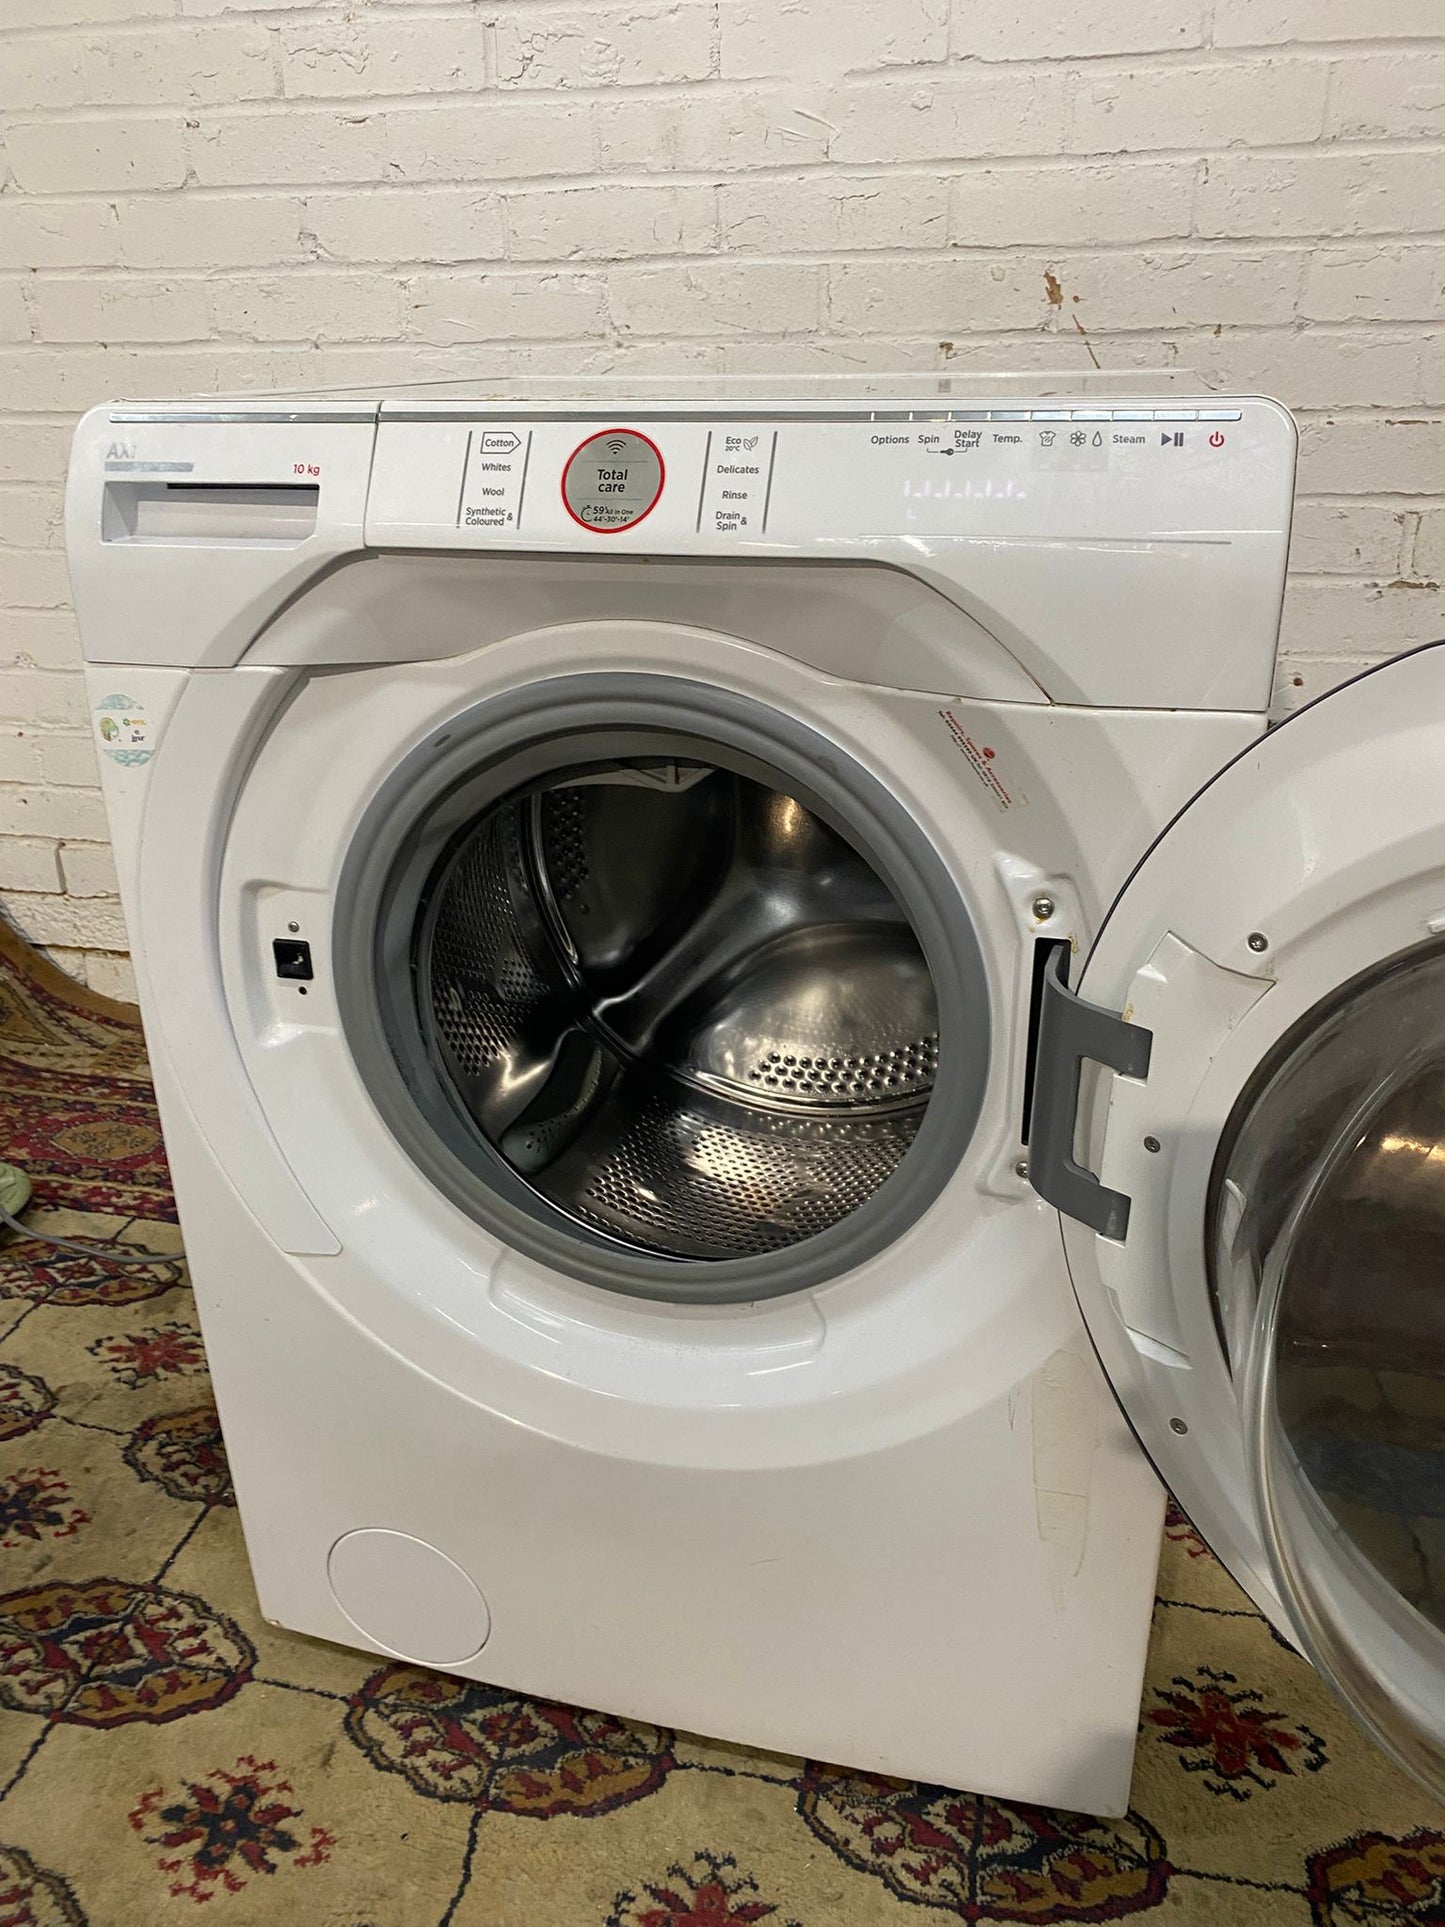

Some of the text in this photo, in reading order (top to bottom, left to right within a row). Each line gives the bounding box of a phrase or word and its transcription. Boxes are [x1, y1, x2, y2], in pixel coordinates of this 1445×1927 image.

[870, 434, 1146, 445] Options Spin Temp. Steam
[954, 430, 982, 440] Delay
[485, 438, 514, 447] Cotton
[725, 436, 742, 445] Eco
[955, 438, 980, 448] Start
[293, 464, 320, 476] 10 kg
[482, 463, 511, 472] Whites
[717, 465, 759, 474] Delicates
[598, 469, 628, 480] Total
[482, 488, 505, 496] Wool
[598, 483, 625, 493] care
[722, 490, 748, 500] Rinse
[466, 507, 513, 521] Synthetic &
[715, 511, 748, 525] Drain &
[465, 517, 505, 526] Coloured
[716, 521, 737, 531] Spin
